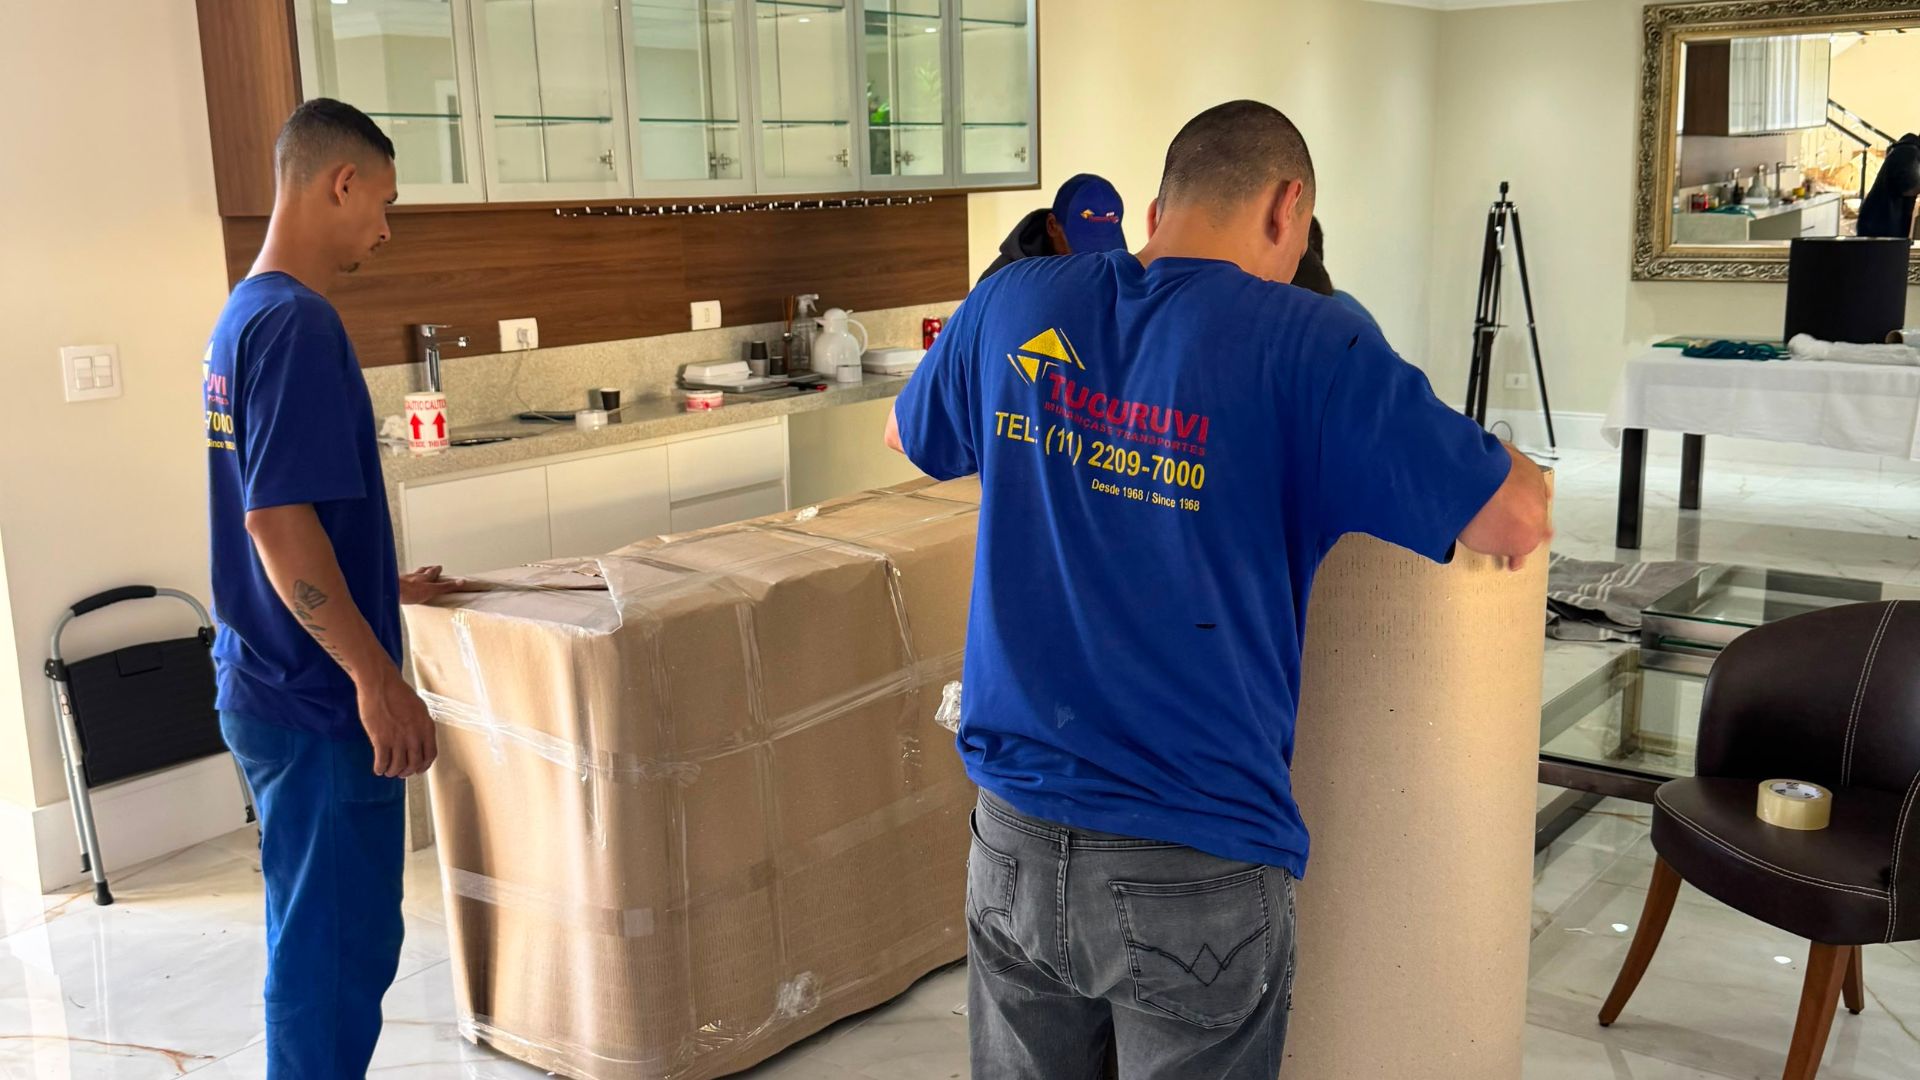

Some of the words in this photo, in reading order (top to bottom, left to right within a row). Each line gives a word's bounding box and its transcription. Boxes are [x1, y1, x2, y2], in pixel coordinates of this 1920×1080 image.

[1049, 372, 1210, 443] TUCURUVI
[995, 411, 1039, 444] TEL:
[1045, 424, 1083, 466] (11)
[1088, 441, 1205, 490] 2209-7000
[1117, 429, 1206, 456] TRANSPORTES
[1091, 478, 1120, 496] Desde
[1122, 486, 1144, 501] 1968
[1152, 492, 1176, 508] Since
[1179, 497, 1200, 512] 1968
